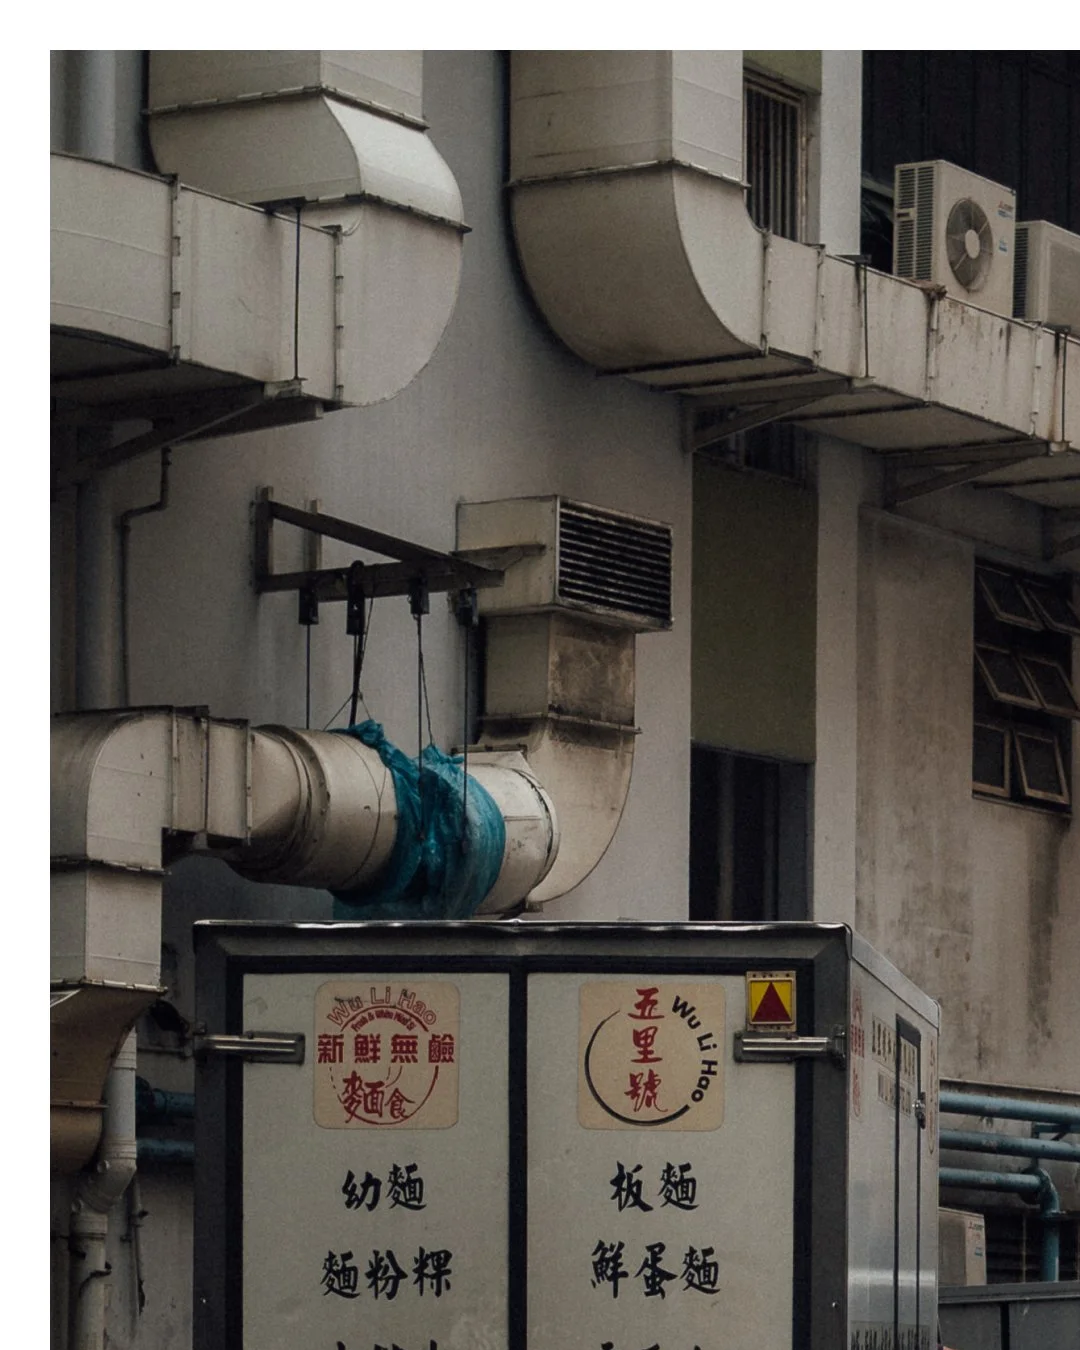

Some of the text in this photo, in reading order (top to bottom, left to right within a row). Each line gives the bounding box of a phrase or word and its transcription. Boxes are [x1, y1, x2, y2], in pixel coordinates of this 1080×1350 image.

[327, 986, 437, 1027] Wu Li Hao
[317, 1033, 455, 1064] 新鮮無鹼
[624, 987, 669, 1113] 五里號
[671, 995, 718, 1102] Wu Li Hao
[342, 1070, 416, 1124] 麵食
[341, 1162, 428, 1212] 幼麵
[609, 1160, 700, 1212] 板麵
[320, 1246, 454, 1301] 麵粉粿
[590, 1239, 721, 1300] 鮮蛋麵
